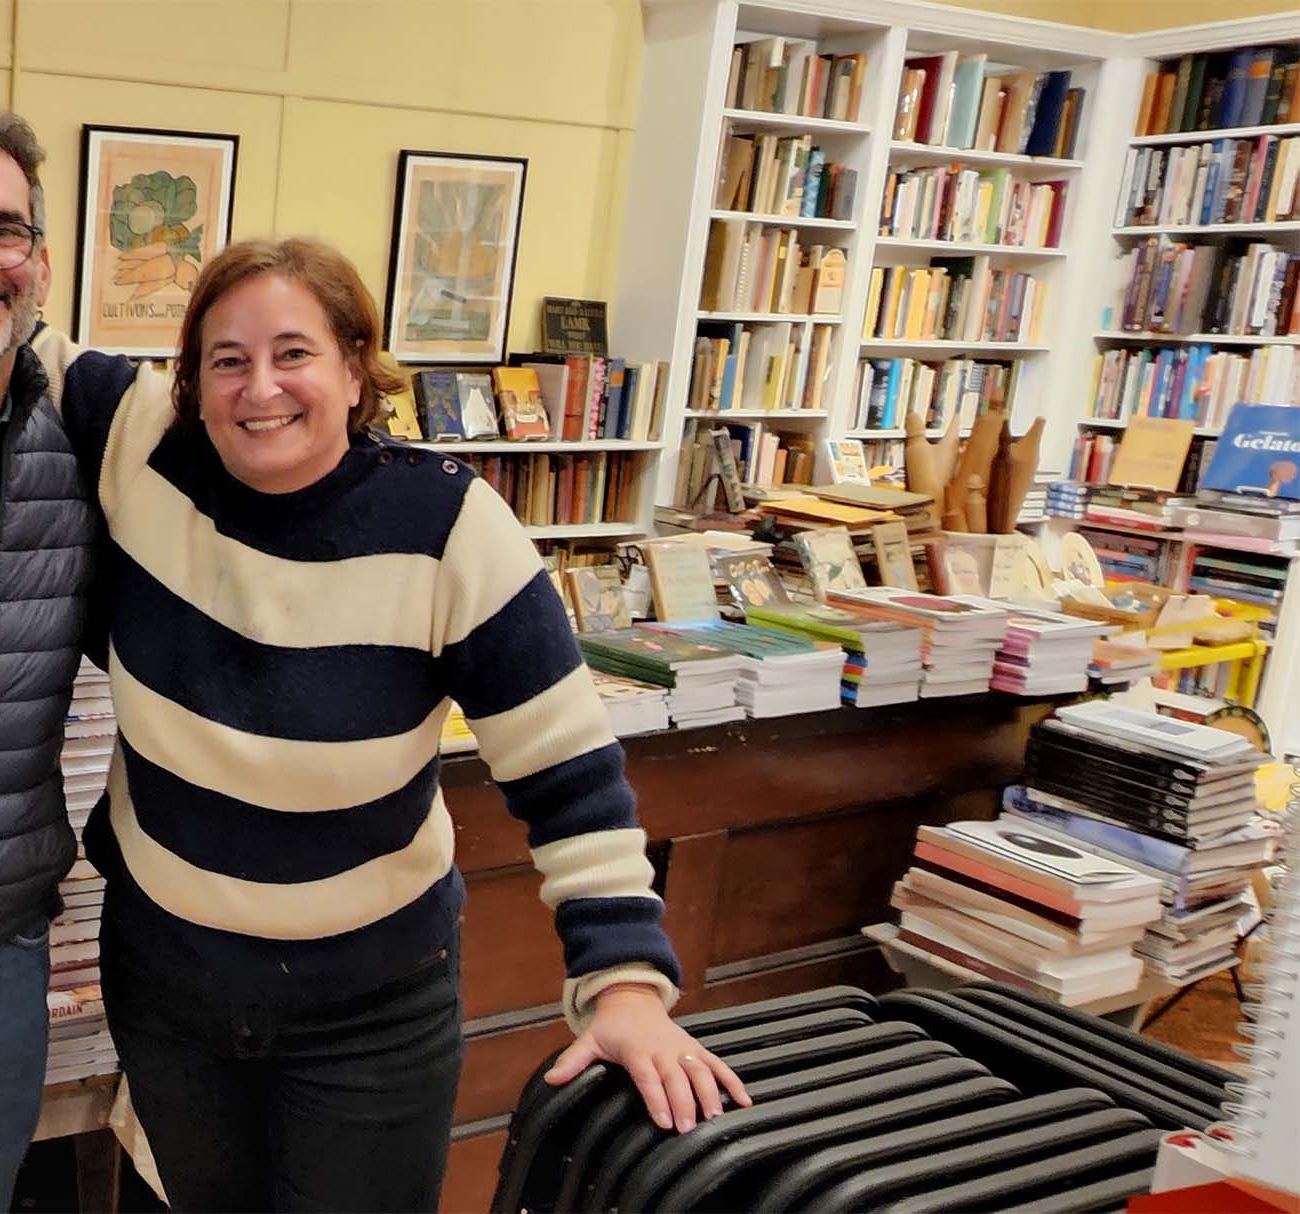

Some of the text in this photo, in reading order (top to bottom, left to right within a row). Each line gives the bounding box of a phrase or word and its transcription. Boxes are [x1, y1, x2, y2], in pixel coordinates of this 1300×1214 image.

[102, 303, 156, 318] CULTIVONS
[1233, 433, 1300, 453] Gelato
[51, 1003, 83, 1019] RDAIN
